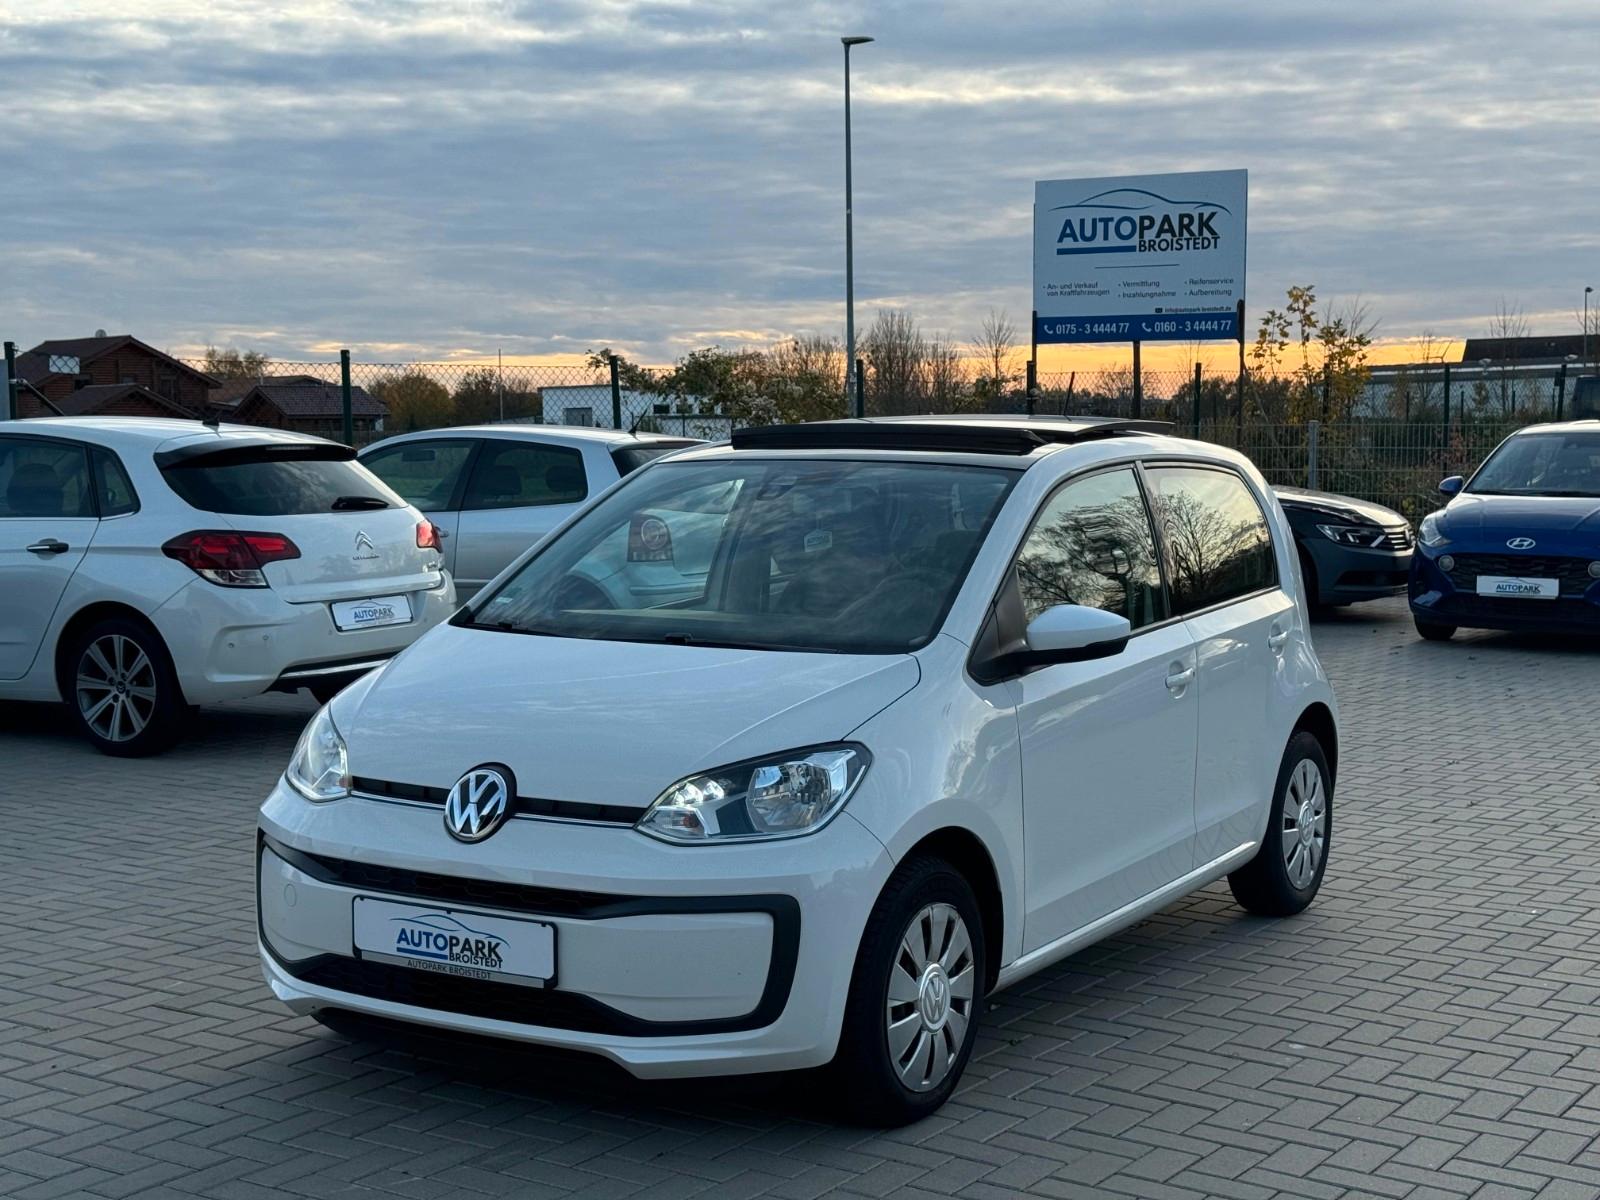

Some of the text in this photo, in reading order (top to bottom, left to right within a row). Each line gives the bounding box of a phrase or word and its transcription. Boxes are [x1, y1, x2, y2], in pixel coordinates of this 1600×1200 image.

[1057, 211, 1218, 243] AUTOPARK
[1138, 235, 1220, 252] BROISTEDT
[1074, 281, 1098, 289] Verkauf
[1122, 279, 1160, 288] Vermittlung
[1189, 277, 1234, 286] Reifenservice
[1060, 289, 1110, 298] Kraftfahrzeugen
[1122, 290, 1177, 299] Inzahlungnahme
[1189, 289, 1232, 297] Aufbereitung
[1056, 324, 1077, 335] 0175
[1084, 323, 1091, 334] 3
[1092, 323, 1117, 334] 4444
[1118, 322, 1130, 333] 77
[1154, 321, 1177, 333] 0160
[1185, 321, 1192, 332] 3
[1193, 320, 1219, 332] 4444
[1220, 319, 1232, 331] 77
[1496, 583, 1541, 592] AUTOPARK
[353, 607, 394, 619] AUTOPARK
[396, 927, 502, 960] AUTOPARK
[449, 952, 503, 969] BROISTEDT
[407, 959, 491, 980] AUTOPARK BROISTEDT
